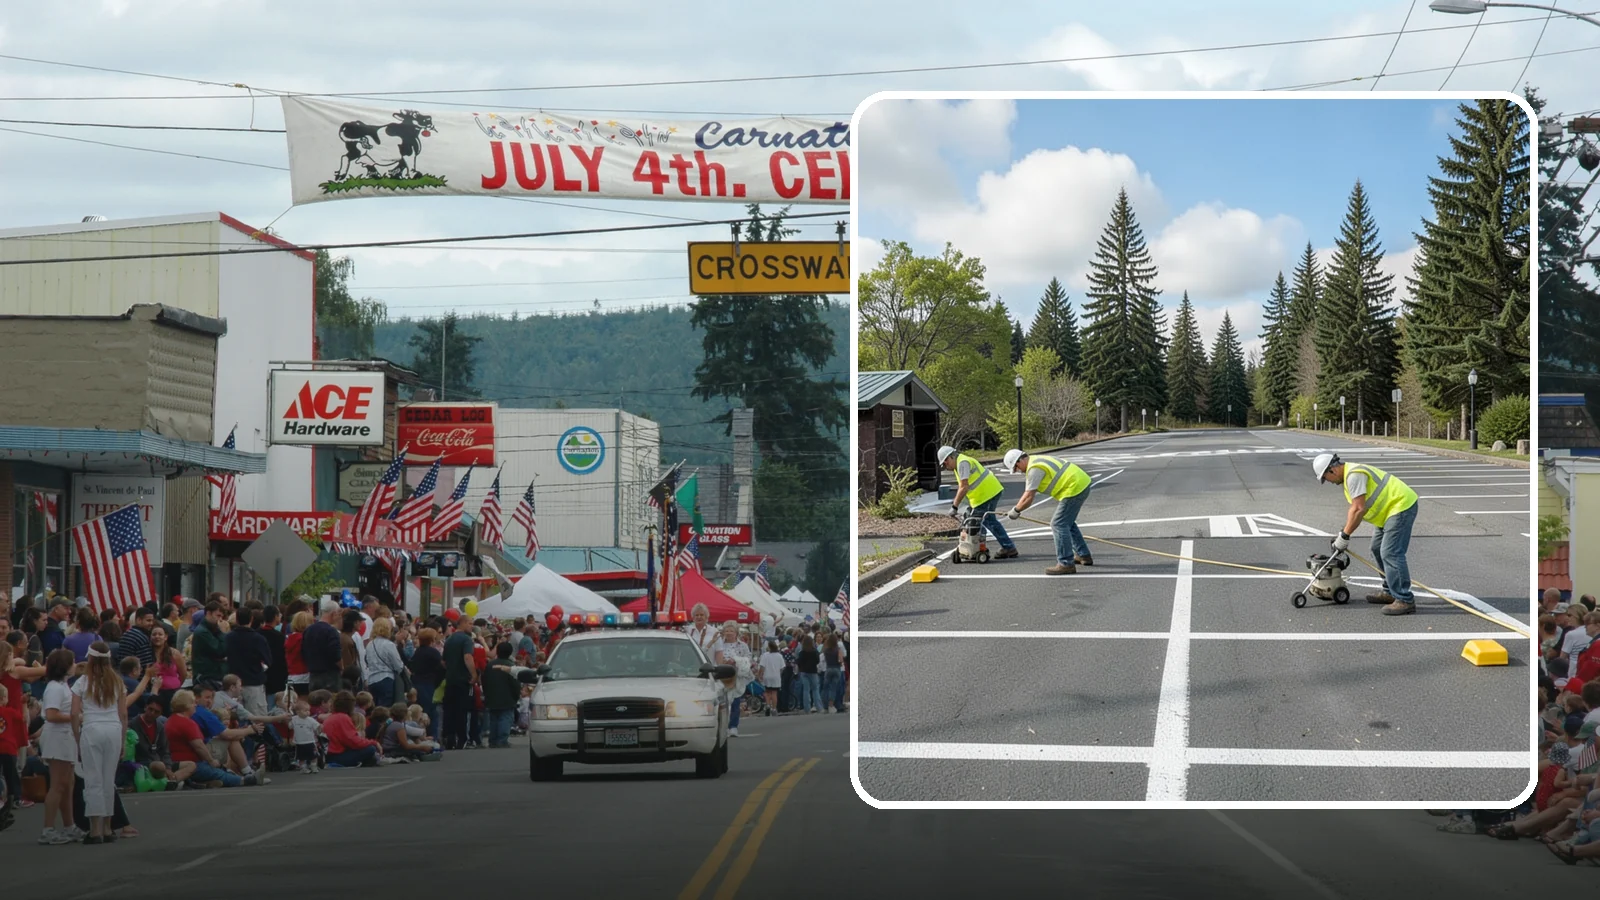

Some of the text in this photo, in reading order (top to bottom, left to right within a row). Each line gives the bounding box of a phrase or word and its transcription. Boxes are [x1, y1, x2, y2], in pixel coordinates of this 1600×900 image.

[695, 121, 850, 150] Carnat
[481, 141, 605, 191] JULY
[632, 150, 746, 198] 4th.
[697, 254, 850, 280] CROSSWA
[283, 380, 373, 420] ACE
[406, 409, 485, 422] CEDAR LOG
[284, 421, 371, 437] Hardware
[416, 428, 477, 447] Coca-Cola
[353, 467, 385, 480] Simpl
[95, 485, 124, 494] Vincent
[126, 486, 136, 495] de
[138, 486, 155, 495] Paul
[688, 526, 742, 535] CRNATION
[699, 535, 730, 543] GLASS
